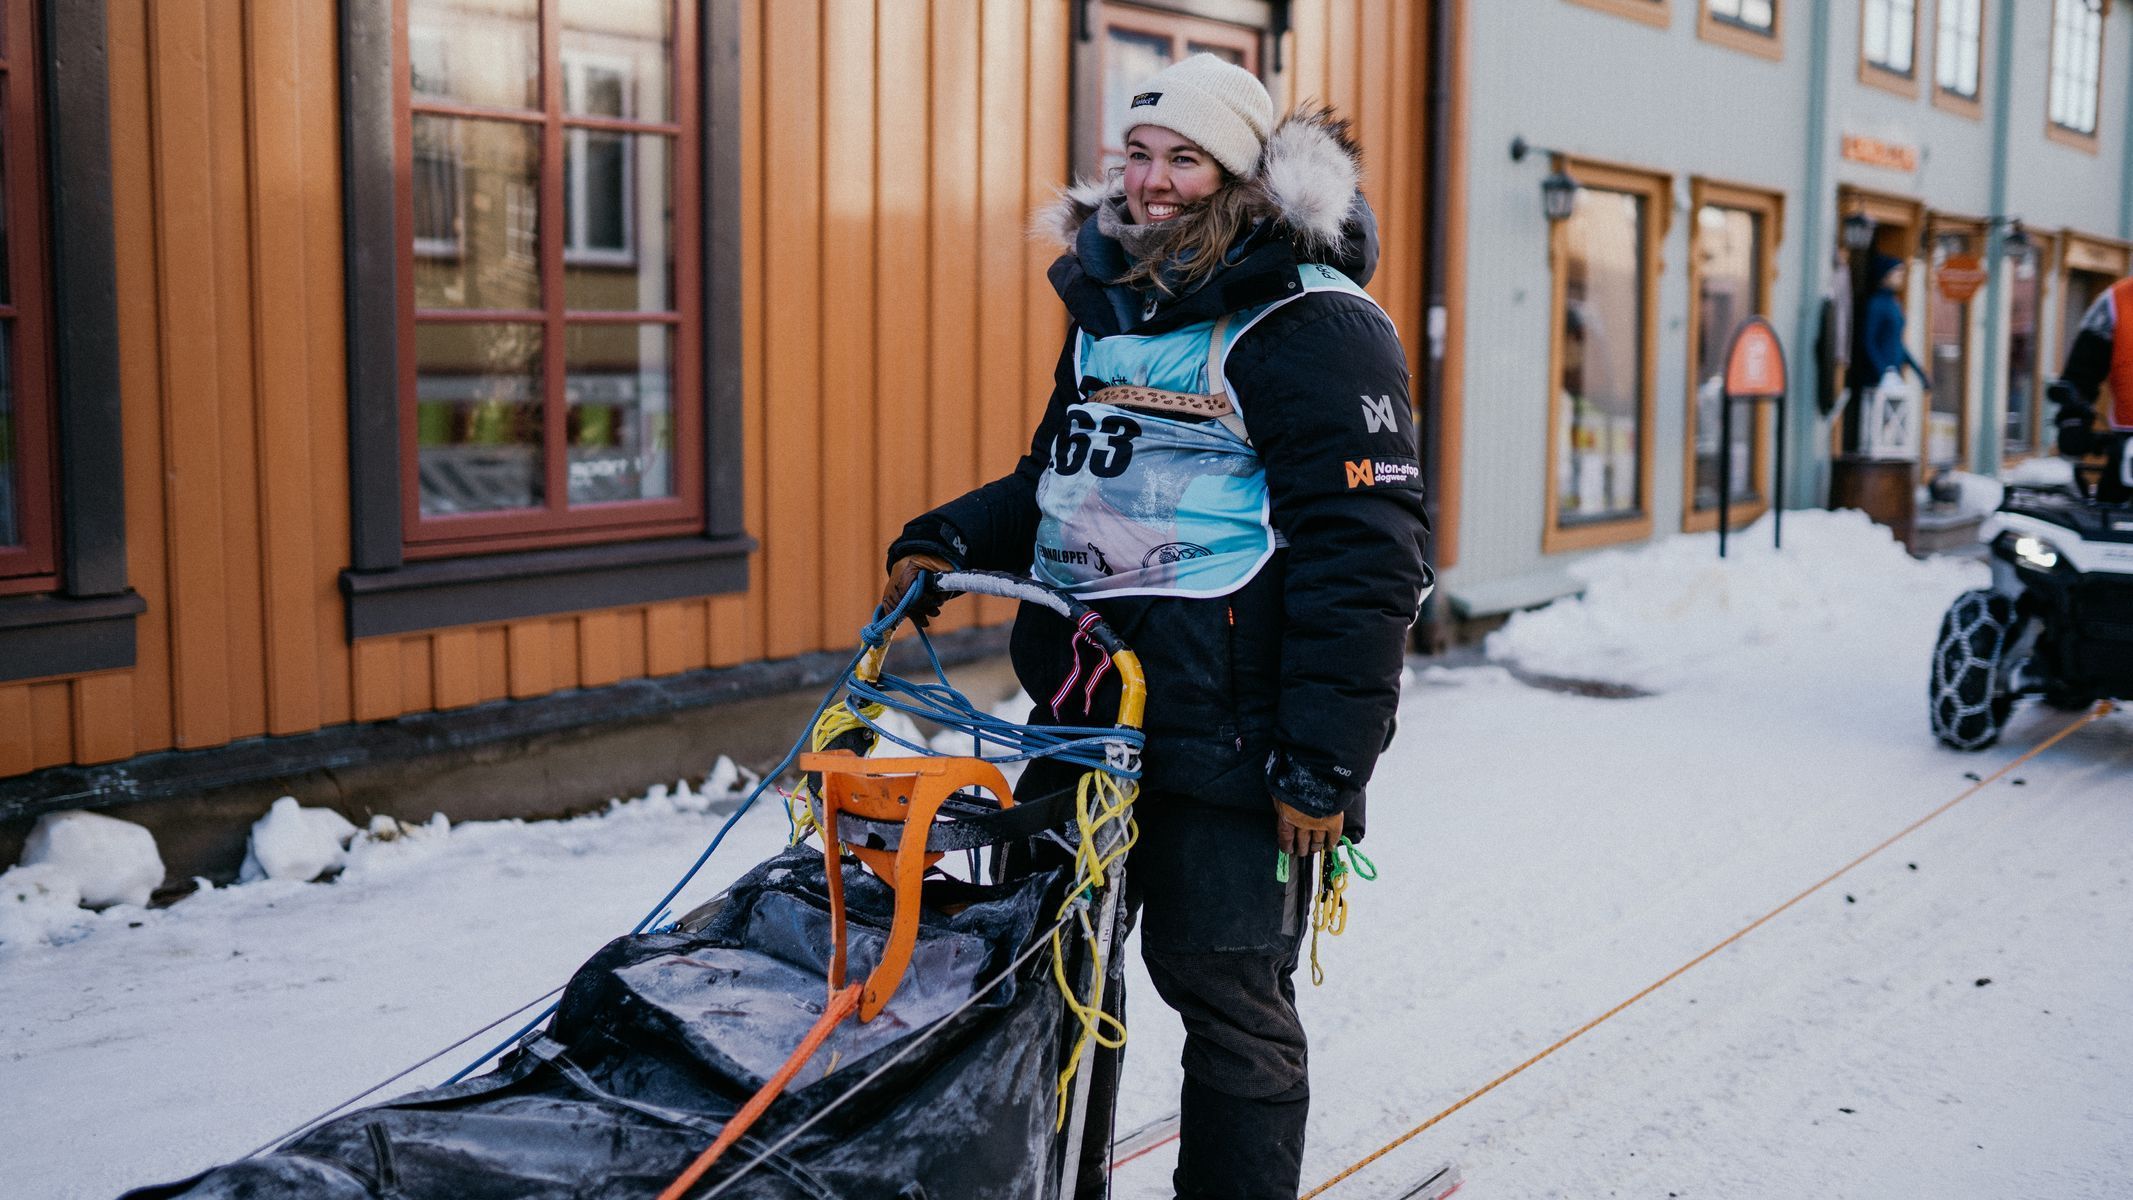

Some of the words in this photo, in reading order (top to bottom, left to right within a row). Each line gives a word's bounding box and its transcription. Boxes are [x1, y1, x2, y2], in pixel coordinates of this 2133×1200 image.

[1053, 409, 1142, 479] 63
[1375, 461, 1419, 478] Non-stop
[1374, 474, 1408, 483] dogwear
